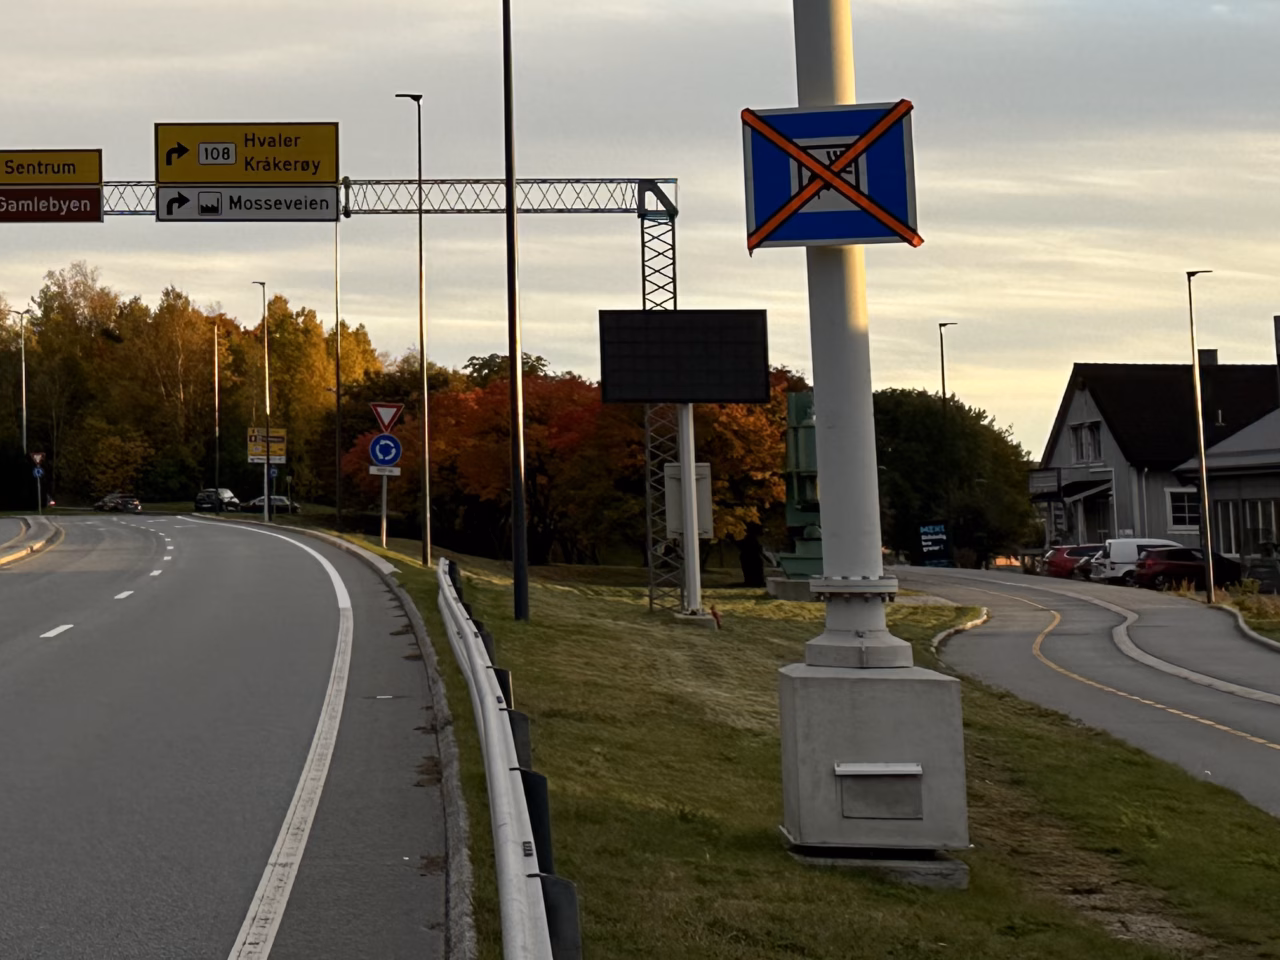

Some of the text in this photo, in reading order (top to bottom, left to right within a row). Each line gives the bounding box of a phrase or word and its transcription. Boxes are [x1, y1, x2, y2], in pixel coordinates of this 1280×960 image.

[244, 133, 302, 148] Hvaler
[204, 147, 231, 161] 108
[4, 159, 76, 175] Sentrum
[244, 156, 321, 176] Kråkerøy
[229, 195, 329, 211] Mosseveien
